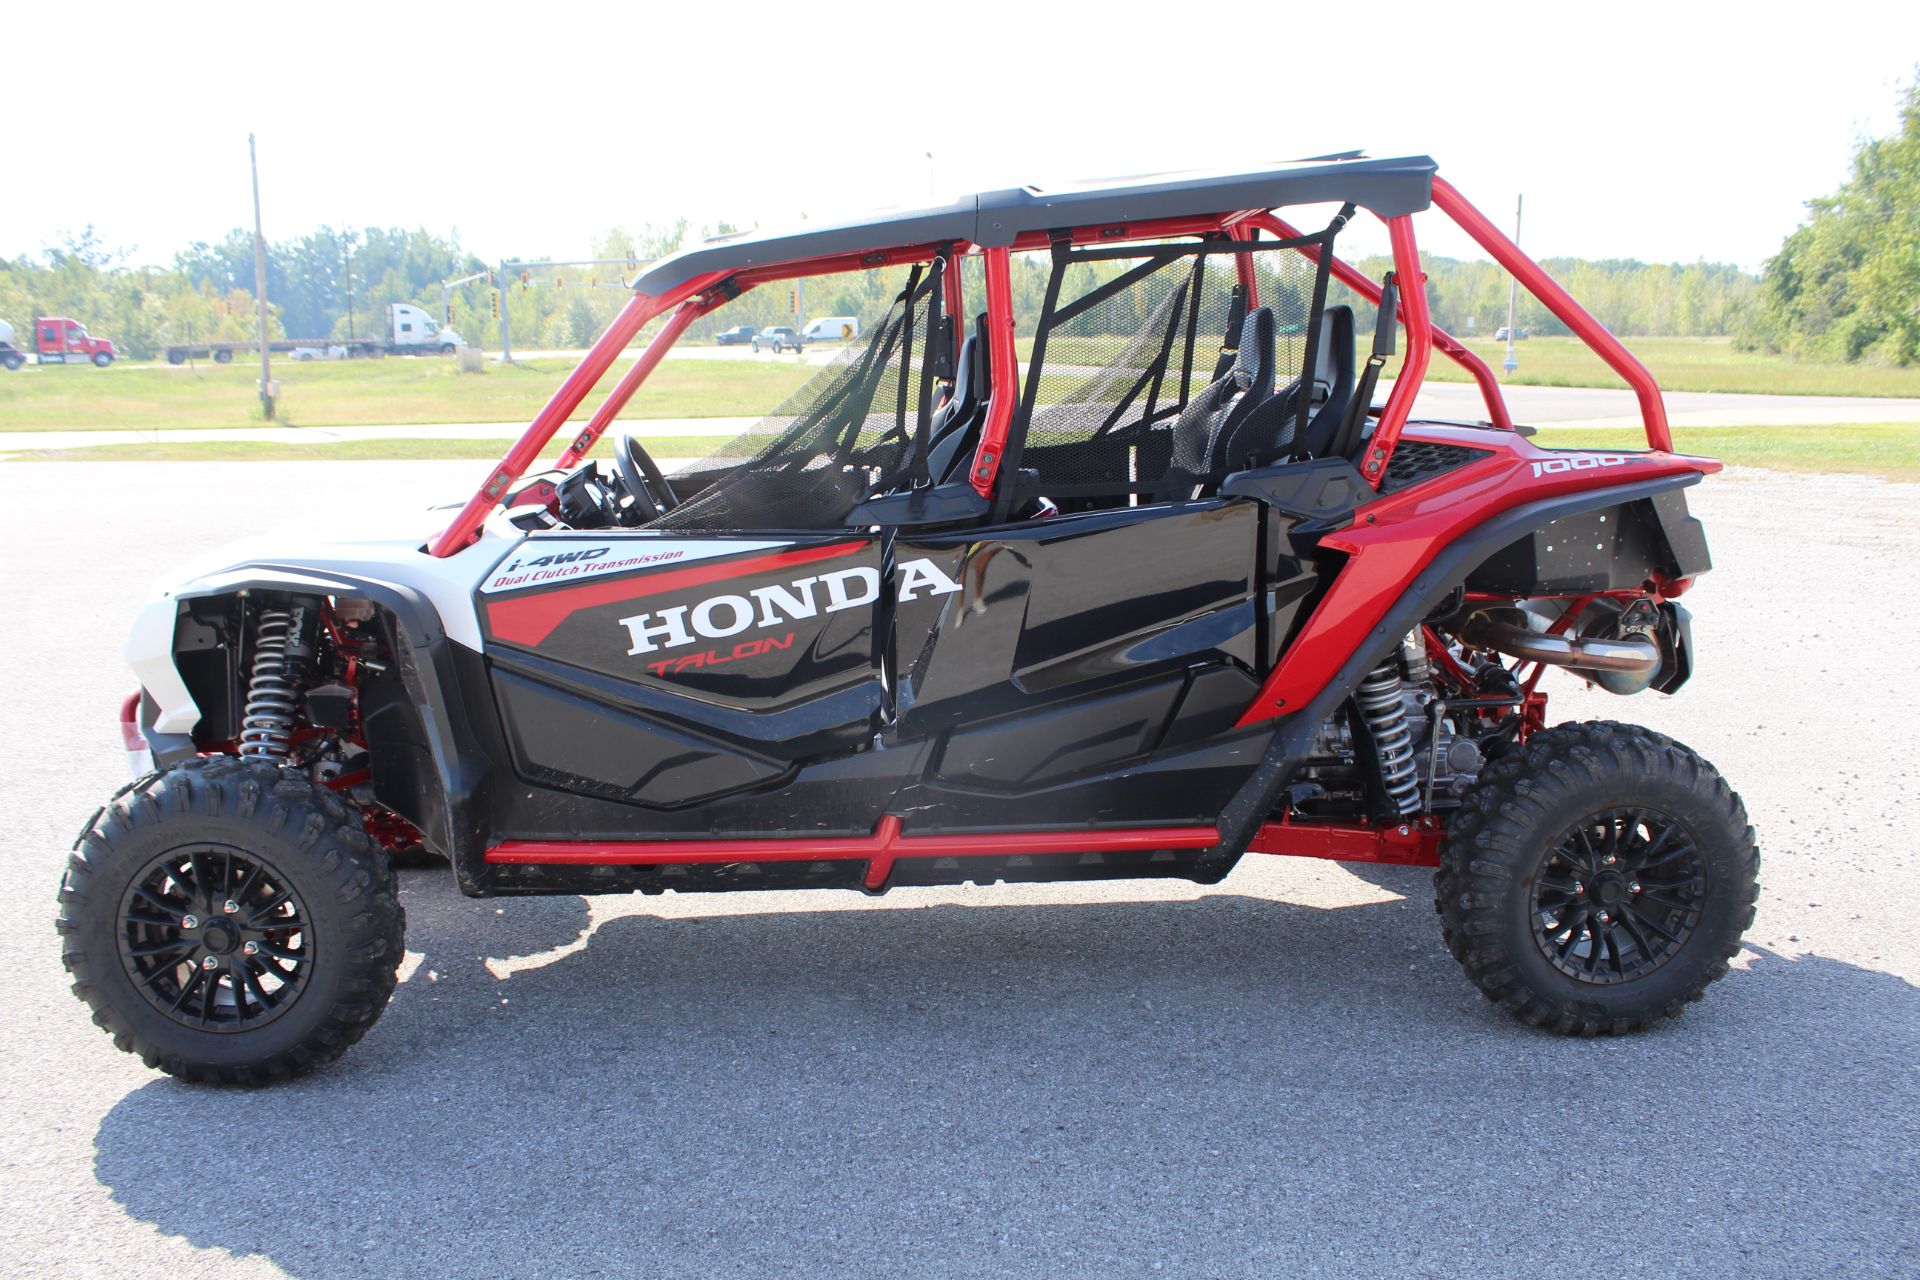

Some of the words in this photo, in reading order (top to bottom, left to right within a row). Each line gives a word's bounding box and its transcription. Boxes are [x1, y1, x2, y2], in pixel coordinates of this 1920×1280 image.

[493, 573, 528, 588] Dual
[531, 565, 580, 581] Clutch
[583, 550, 685, 572] Transmission
[508, 547, 611, 573] i-4WD
[618, 558, 963, 656] HONDA
[647, 632, 796, 678] TALON
